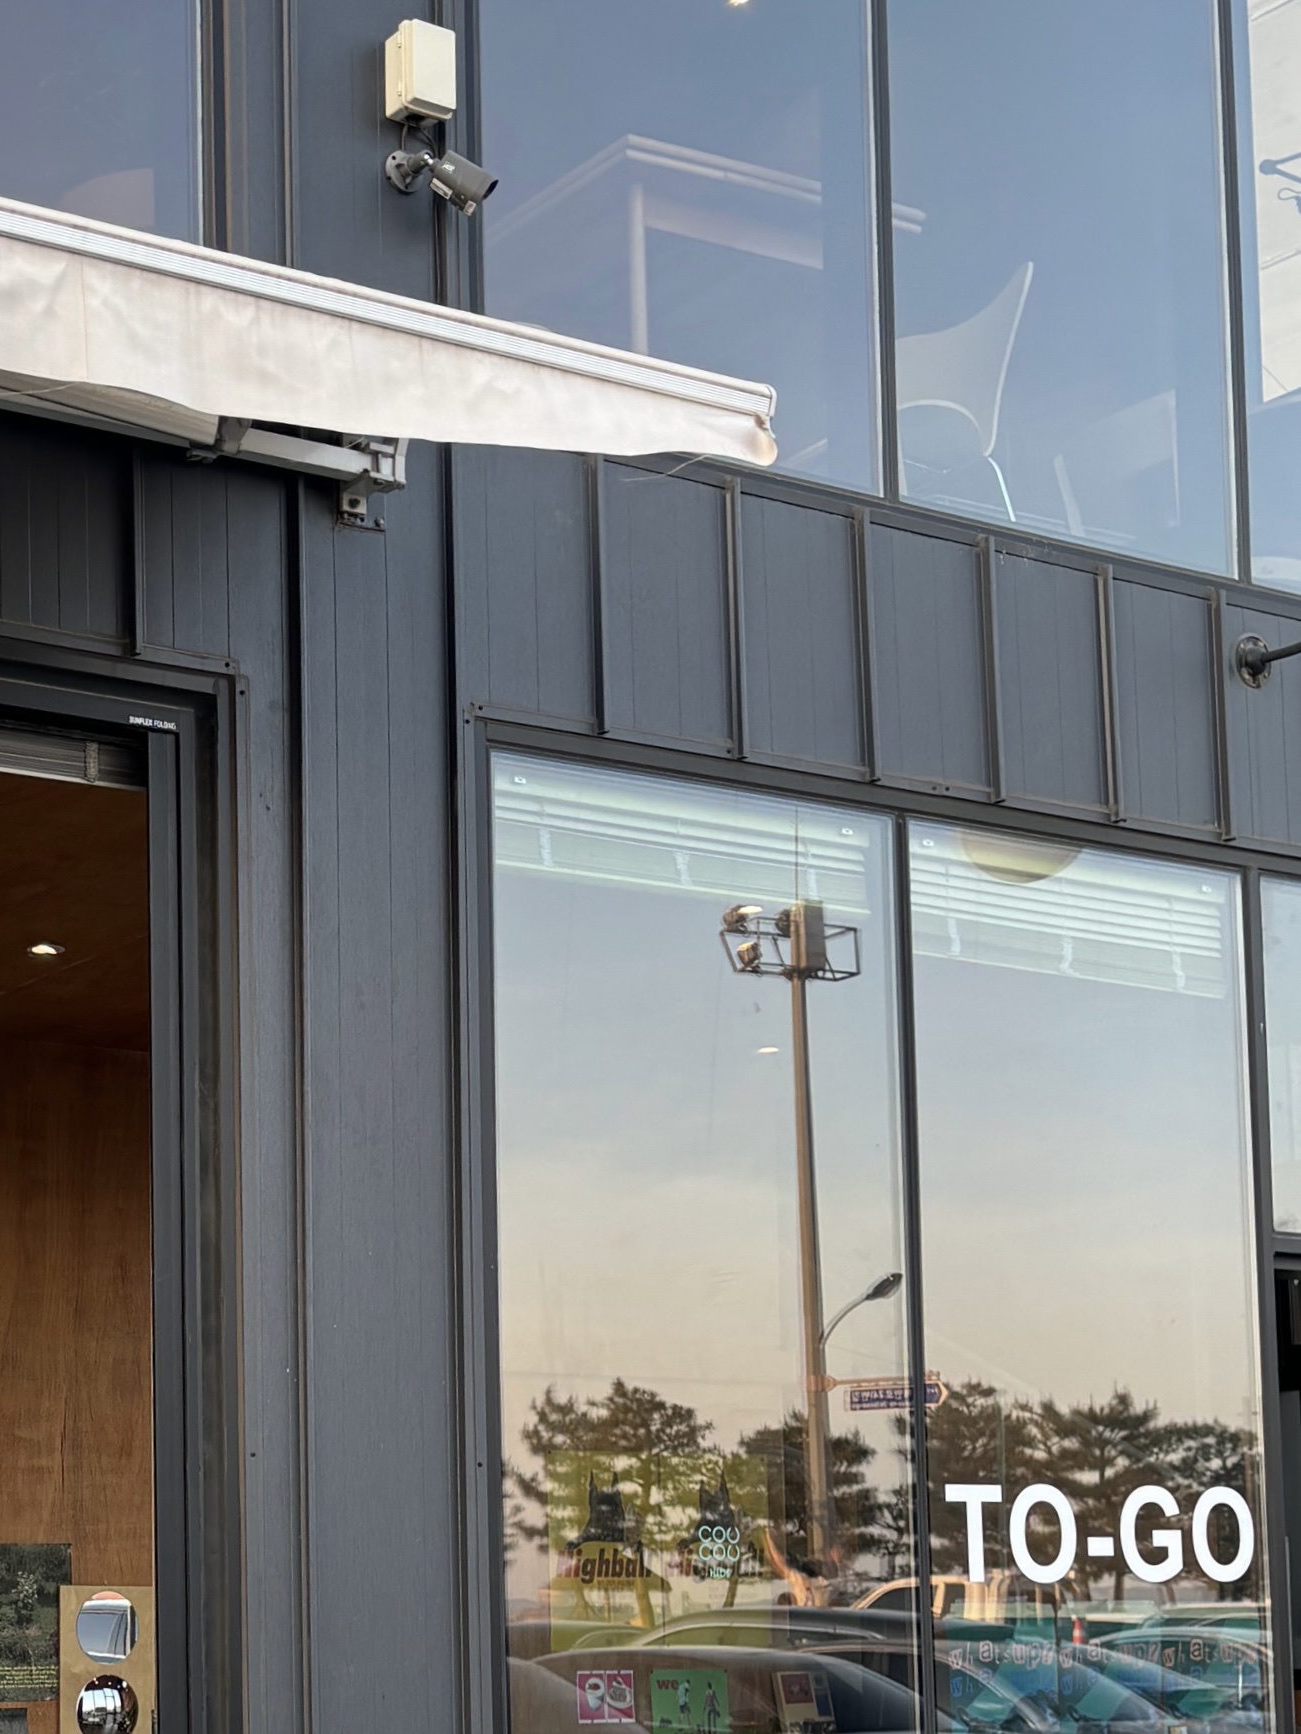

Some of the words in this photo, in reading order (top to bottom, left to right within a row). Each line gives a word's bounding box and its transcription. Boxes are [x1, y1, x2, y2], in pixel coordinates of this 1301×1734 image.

[698, 1525, 740, 1544] COU
[944, 1483, 1255, 1584] TO-GO
[698, 1543, 740, 1563] COU
